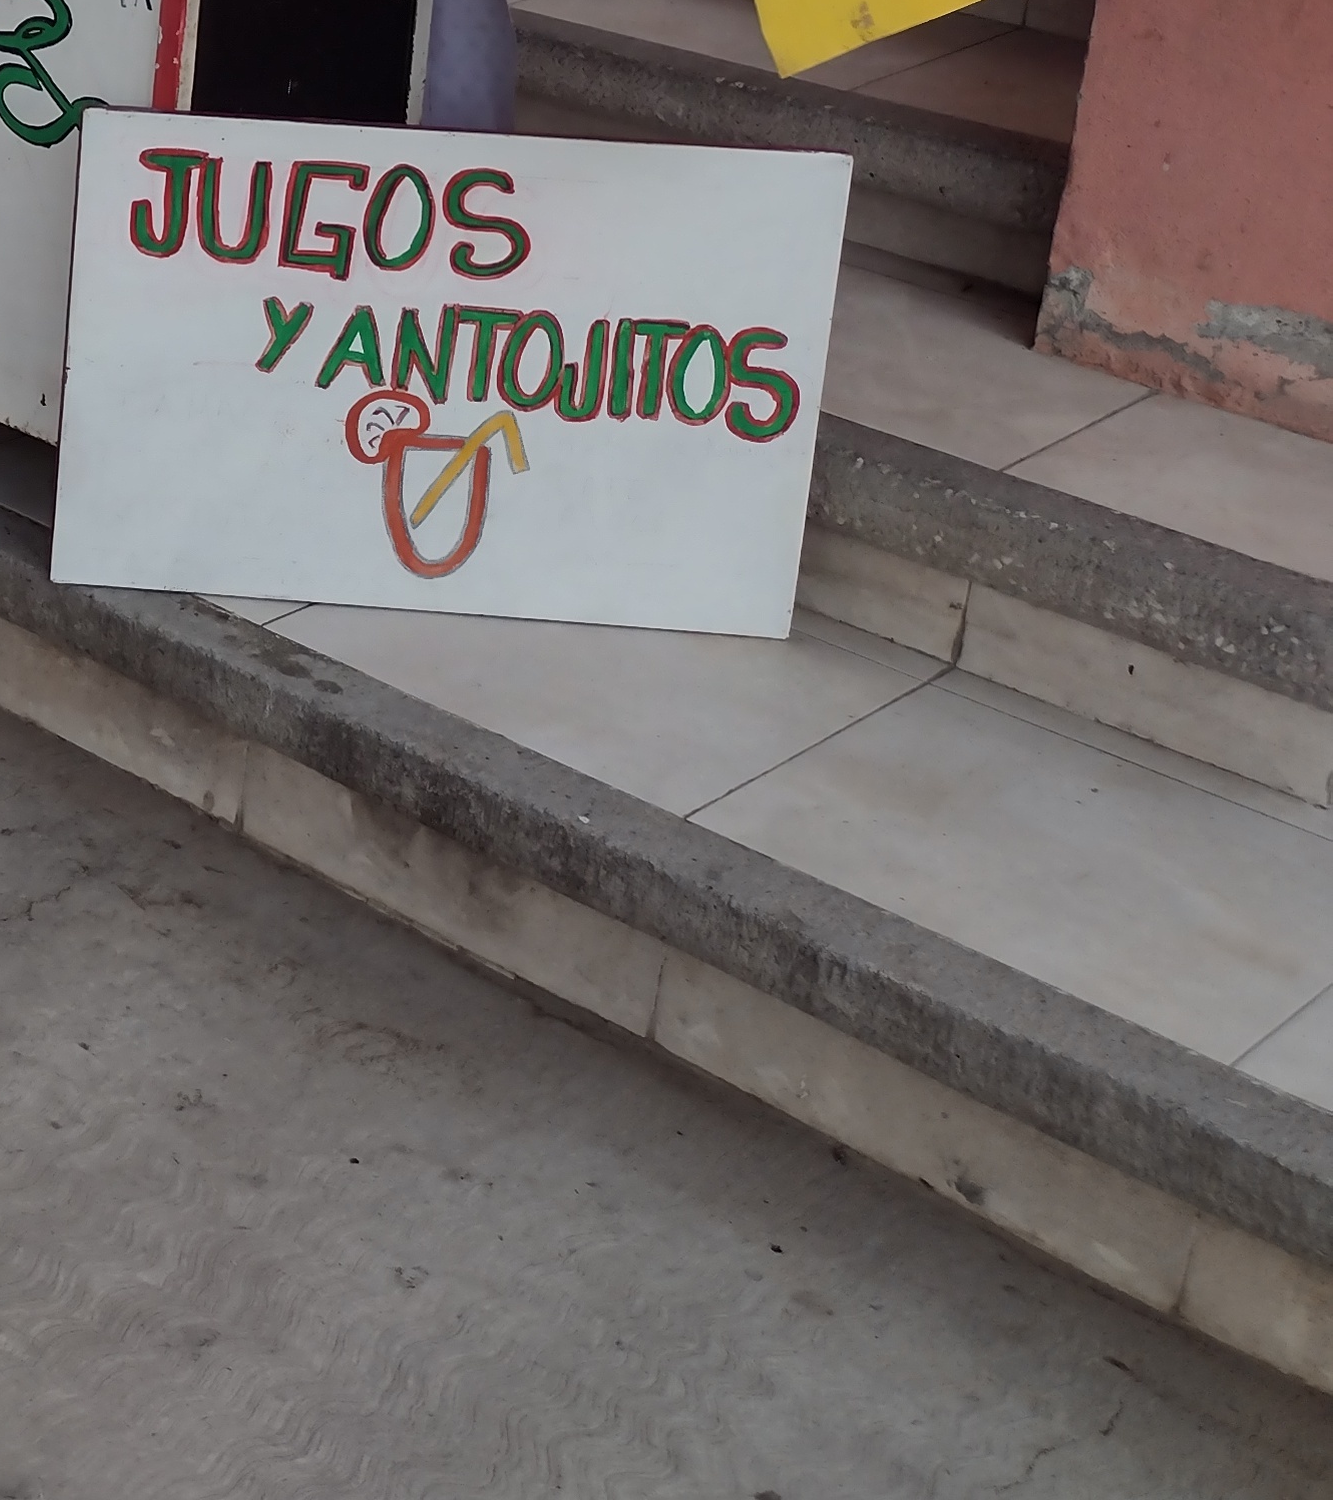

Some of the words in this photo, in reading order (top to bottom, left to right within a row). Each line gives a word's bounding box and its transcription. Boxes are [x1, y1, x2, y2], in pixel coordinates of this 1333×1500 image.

[129, 148, 531, 281] JUGOS
[255, 296, 315, 372] Y
[315, 302, 801, 444] ANTOJITOS
